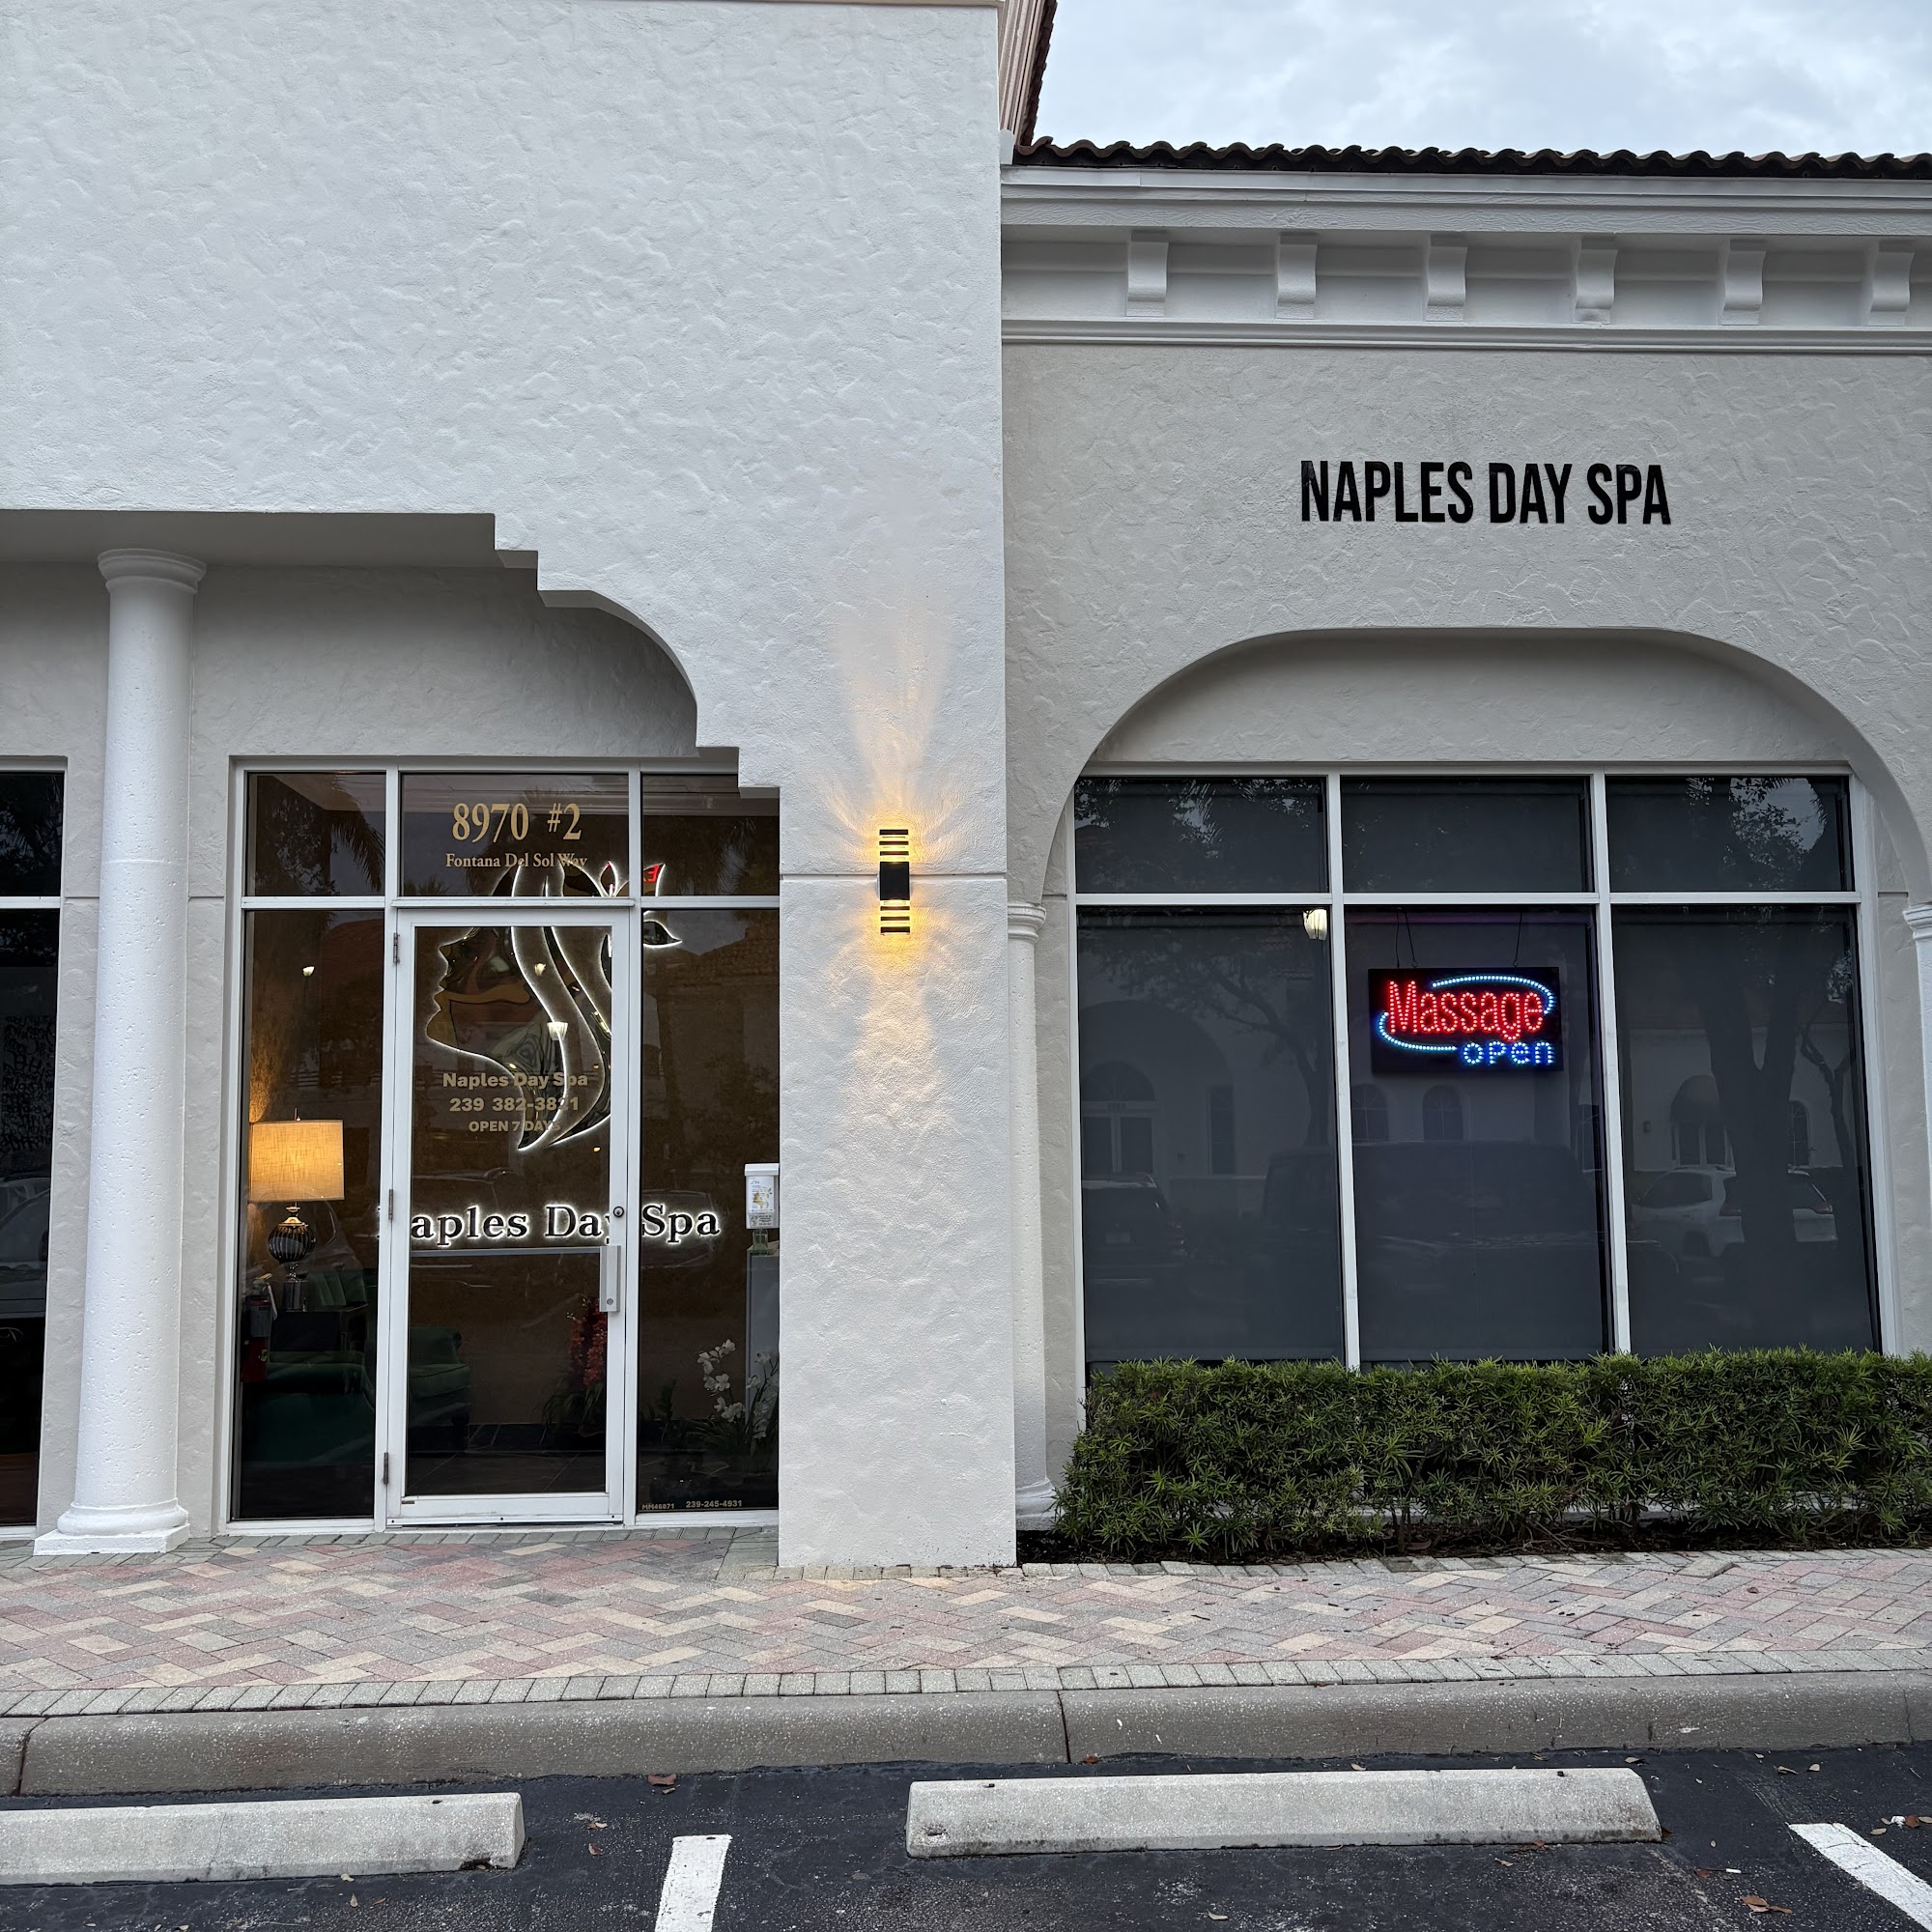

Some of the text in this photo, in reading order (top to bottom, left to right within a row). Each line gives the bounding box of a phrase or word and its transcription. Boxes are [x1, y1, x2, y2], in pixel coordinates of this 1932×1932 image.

[1300, 460, 1671, 525] NAPLES DAY SPA
[451, 803, 582, 842] 8970 #2
[445, 852, 588, 870] Fontana Del Sol Way
[1387, 980, 1544, 1041] Massage
[442, 1071, 588, 1090] Naples Day Spa
[449, 1097, 484, 1112] 239
[469, 1121, 508, 1132] OPEN
[512, 1121, 520, 1131] 7
[410, 1205, 720, 1246] aples Da Spa
[685, 1499, 743, 1508] 239-245-4931
